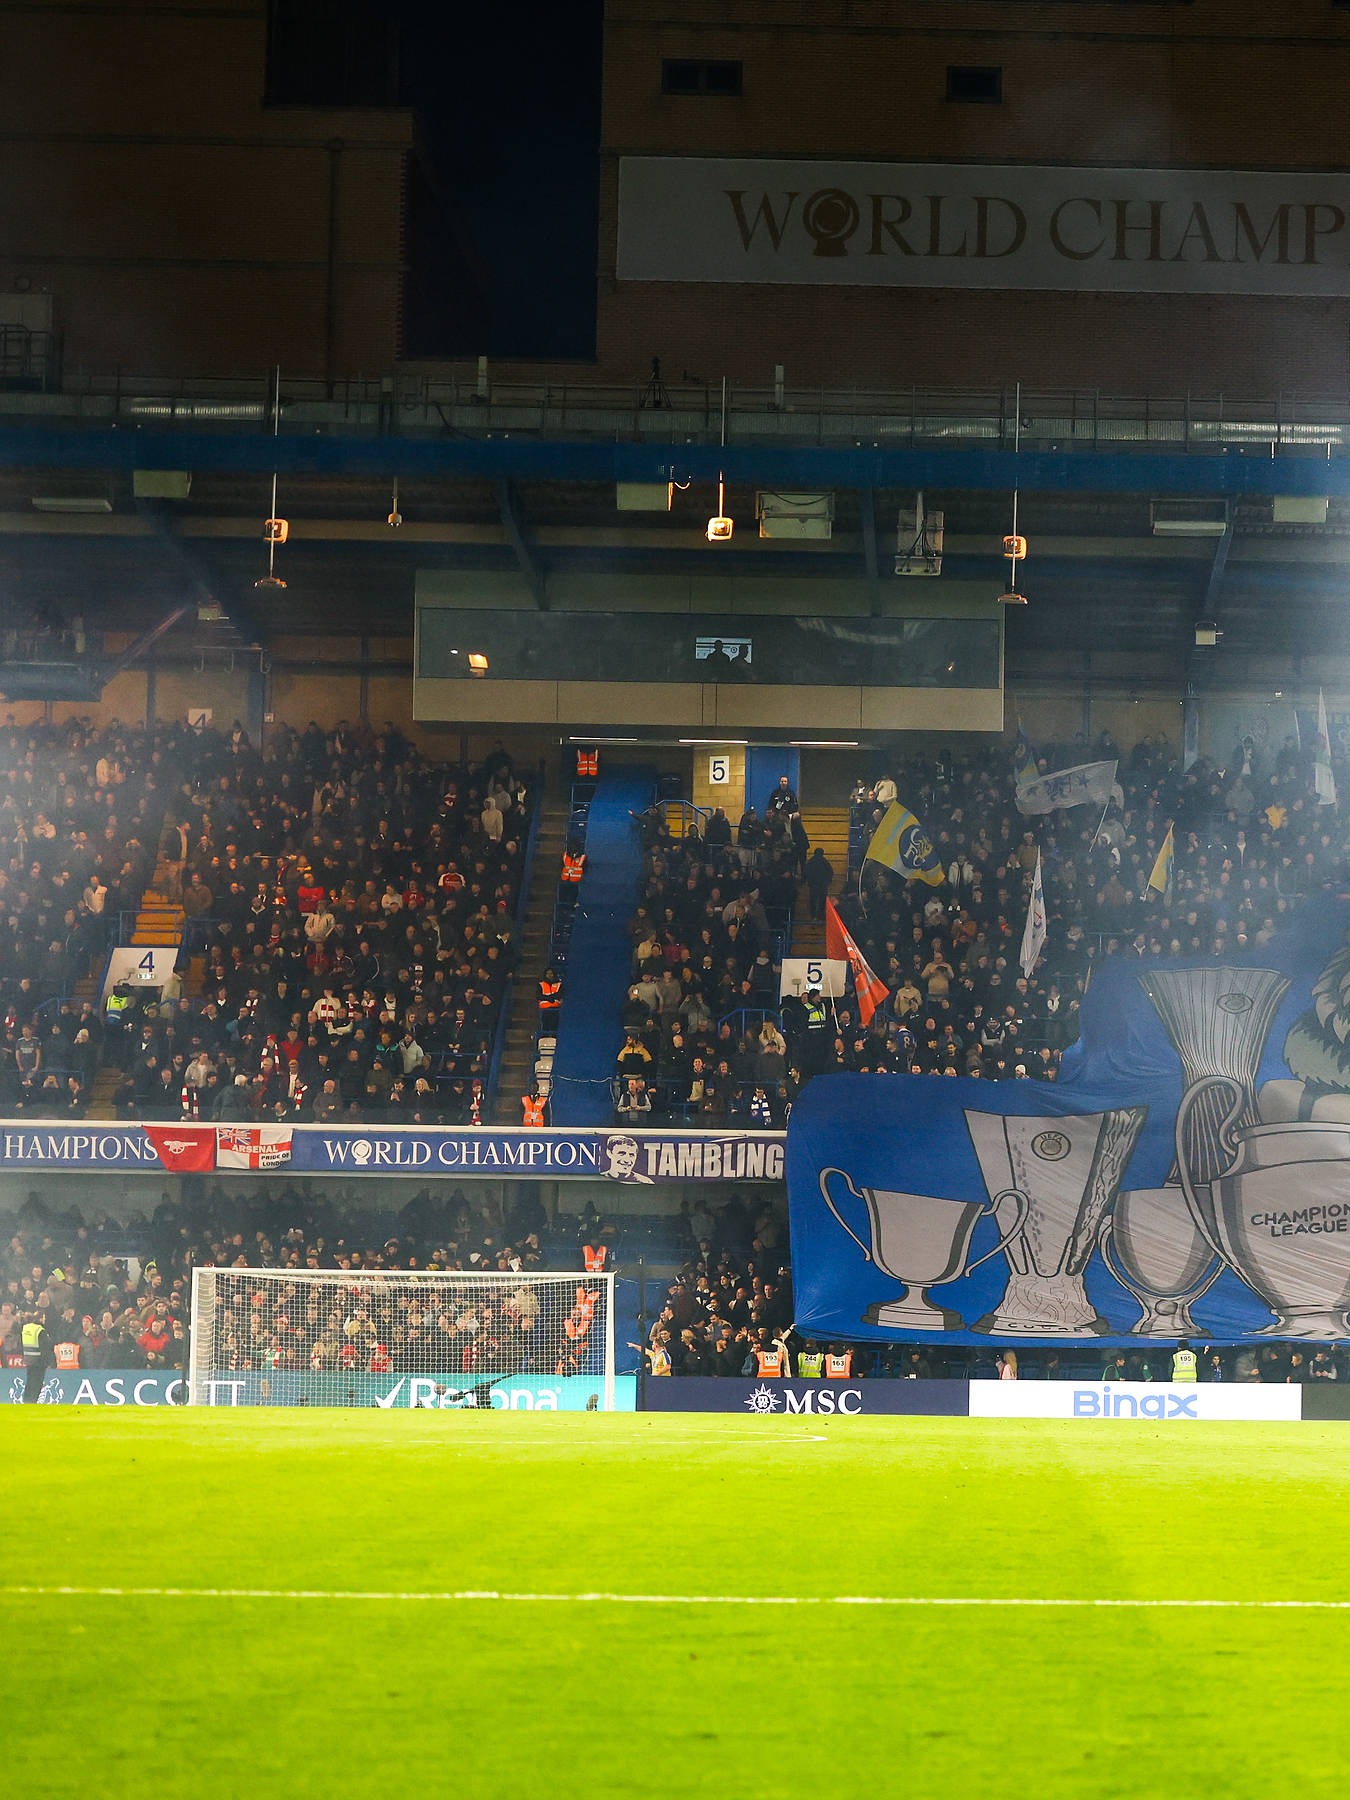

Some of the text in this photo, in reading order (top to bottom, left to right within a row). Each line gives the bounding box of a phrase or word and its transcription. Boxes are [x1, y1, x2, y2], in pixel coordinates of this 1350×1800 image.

[722, 186, 1028, 259] WORLD
[712, 760, 725, 781] 5
[138, 951, 155, 973] 4
[806, 962, 823, 984] 5
[232, 1144, 279, 1154] ARSENAL
[324, 1139, 600, 1167] WORLD CHAMPION
[643, 1142, 785, 1180] TAMBLING
[1270, 1219, 1348, 1237] LEAGUE
[783, 1389, 862, 1415] MSC
